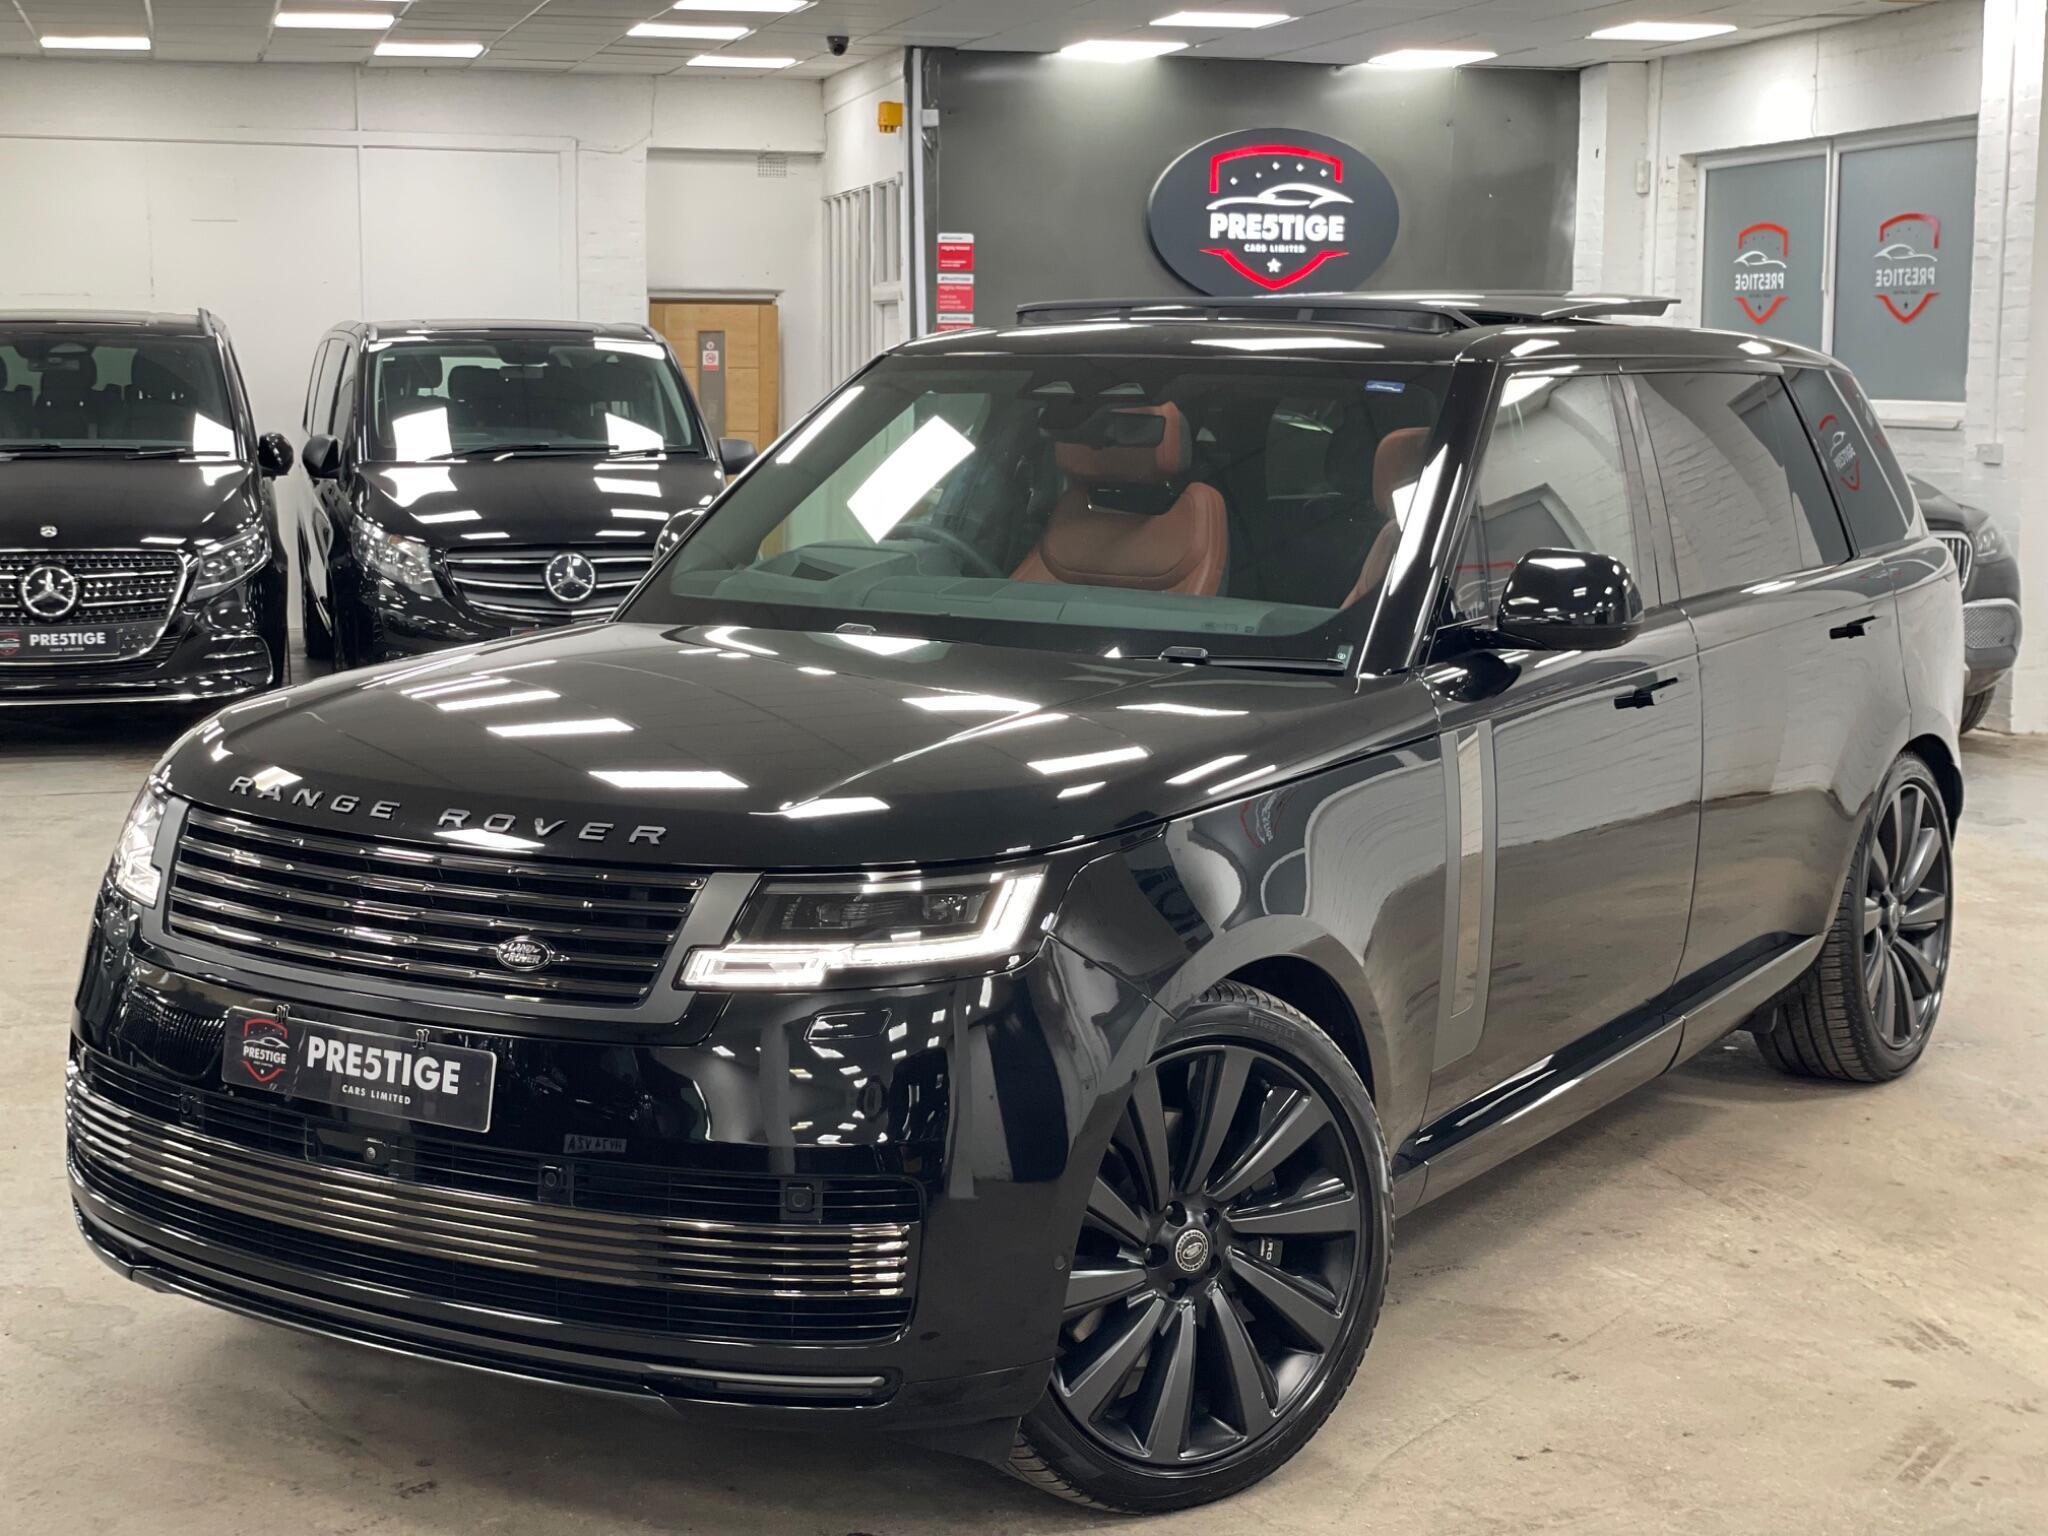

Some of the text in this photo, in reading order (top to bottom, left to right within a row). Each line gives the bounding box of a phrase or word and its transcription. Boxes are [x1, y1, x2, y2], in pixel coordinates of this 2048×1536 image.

[1210, 213, 1345, 241] PRE5TIGE
[1270, 244, 1306, 253] LIMITED
[229, 776, 667, 845] RANGE ROVER
[508, 953, 541, 964] ROVER
[306, 1035, 461, 1095] PRE5TIGE
[342, 1084, 411, 1105] CARS LIMITED
